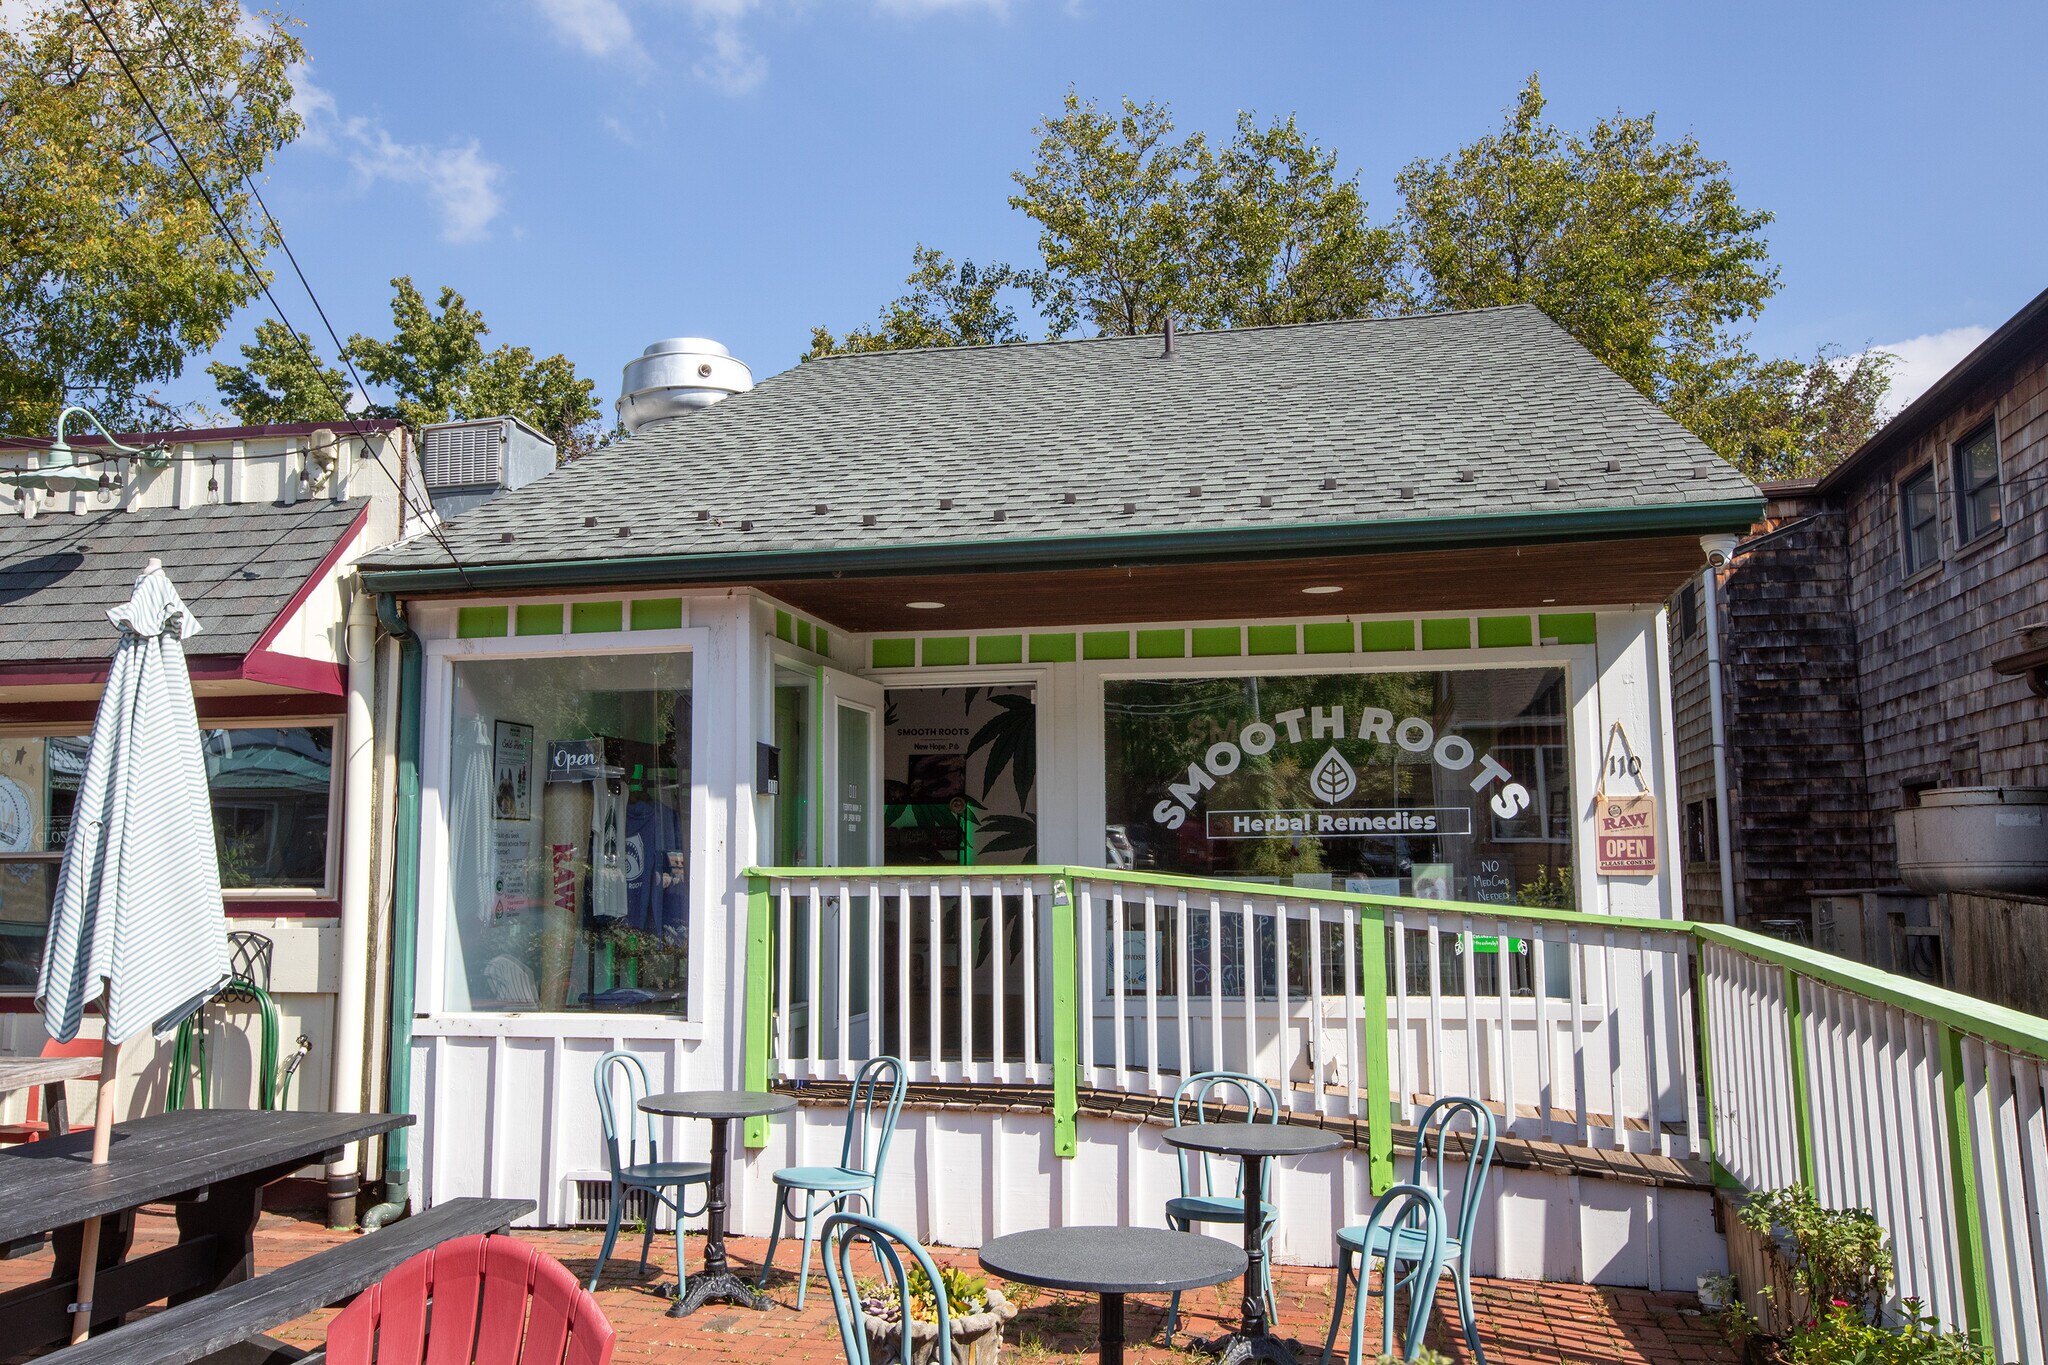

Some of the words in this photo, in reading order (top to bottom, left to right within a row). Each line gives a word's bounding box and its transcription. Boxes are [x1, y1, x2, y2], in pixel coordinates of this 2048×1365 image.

[897, 728, 937, 736] SMOOTH
[939, 728, 970, 736] ROOTS
[554, 750, 597, 774] Open
[1153, 706, 1344, 829] SMOOTH
[1358, 707, 1530, 820] ROOTS
[1609, 755, 1642, 779] 110
[1233, 813, 1310, 834] Herbal
[1318, 811, 1437, 832] Remedies
[1602, 812, 1648, 831] RAW
[35, 831, 68, 843] CLOS
[1606, 839, 1648, 858] OPEN
[1481, 860, 1500, 873] NO
[552, 843, 576, 916] RAW
